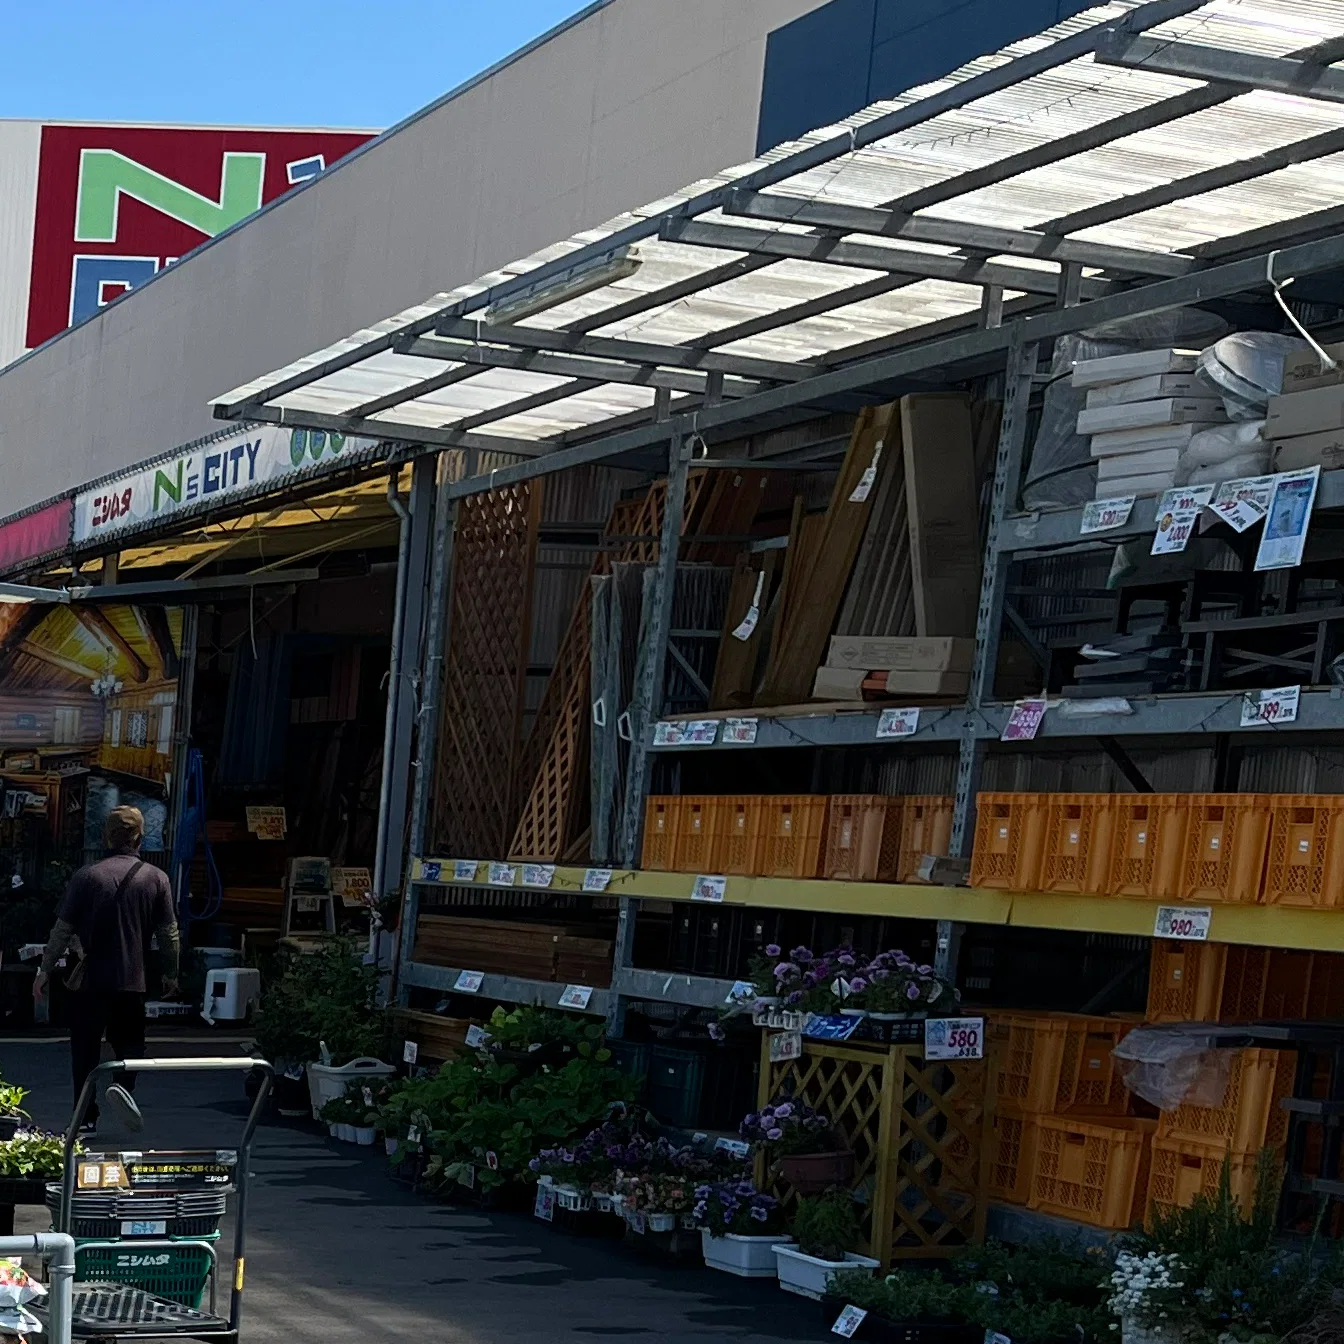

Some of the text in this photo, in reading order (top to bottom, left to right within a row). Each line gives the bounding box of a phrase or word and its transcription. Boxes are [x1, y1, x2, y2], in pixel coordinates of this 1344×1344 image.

[92, 487, 132, 527] ニシムタ
[153, 458, 199, 512] N's
[203, 438, 262, 494] CITY
[1170, 918, 1193, 936] 980
[948, 1030, 978, 1048] 580
[116, 1253, 170, 1267] ニシムタ
